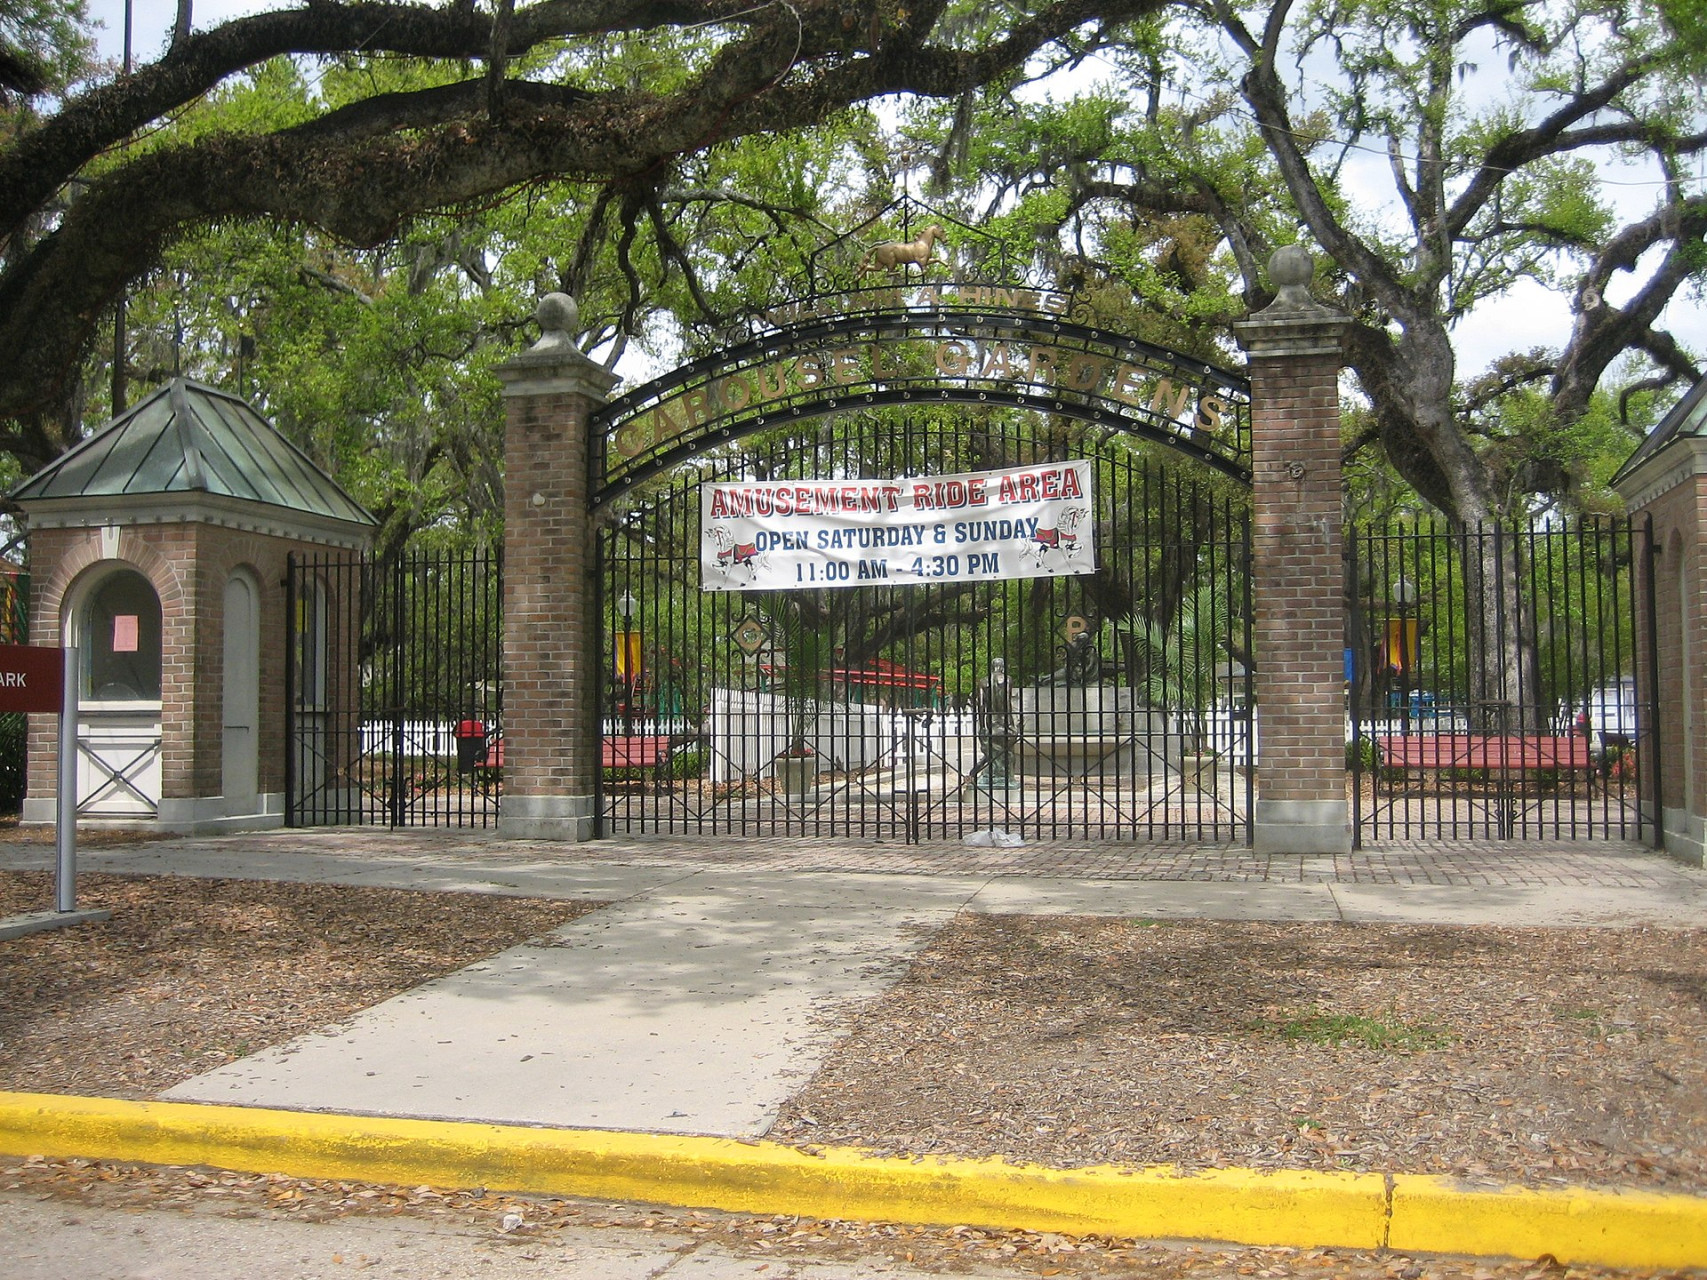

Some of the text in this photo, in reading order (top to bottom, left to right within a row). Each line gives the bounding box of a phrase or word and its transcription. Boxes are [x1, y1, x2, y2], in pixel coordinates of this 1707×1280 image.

[959, 286, 1071, 314] HINES
[614, 341, 1227, 456] CAROUSEL GARDENS
[711, 467, 1083, 518] AMUSEMENT RIDE AREA
[756, 517, 1039, 552] OPEN SATURDAY & SUNDAY
[796, 561, 850, 581] 11:00
[857, 559, 889, 580] AM
[912, 555, 959, 577] 4:30
[967, 552, 1000, 575] PM
